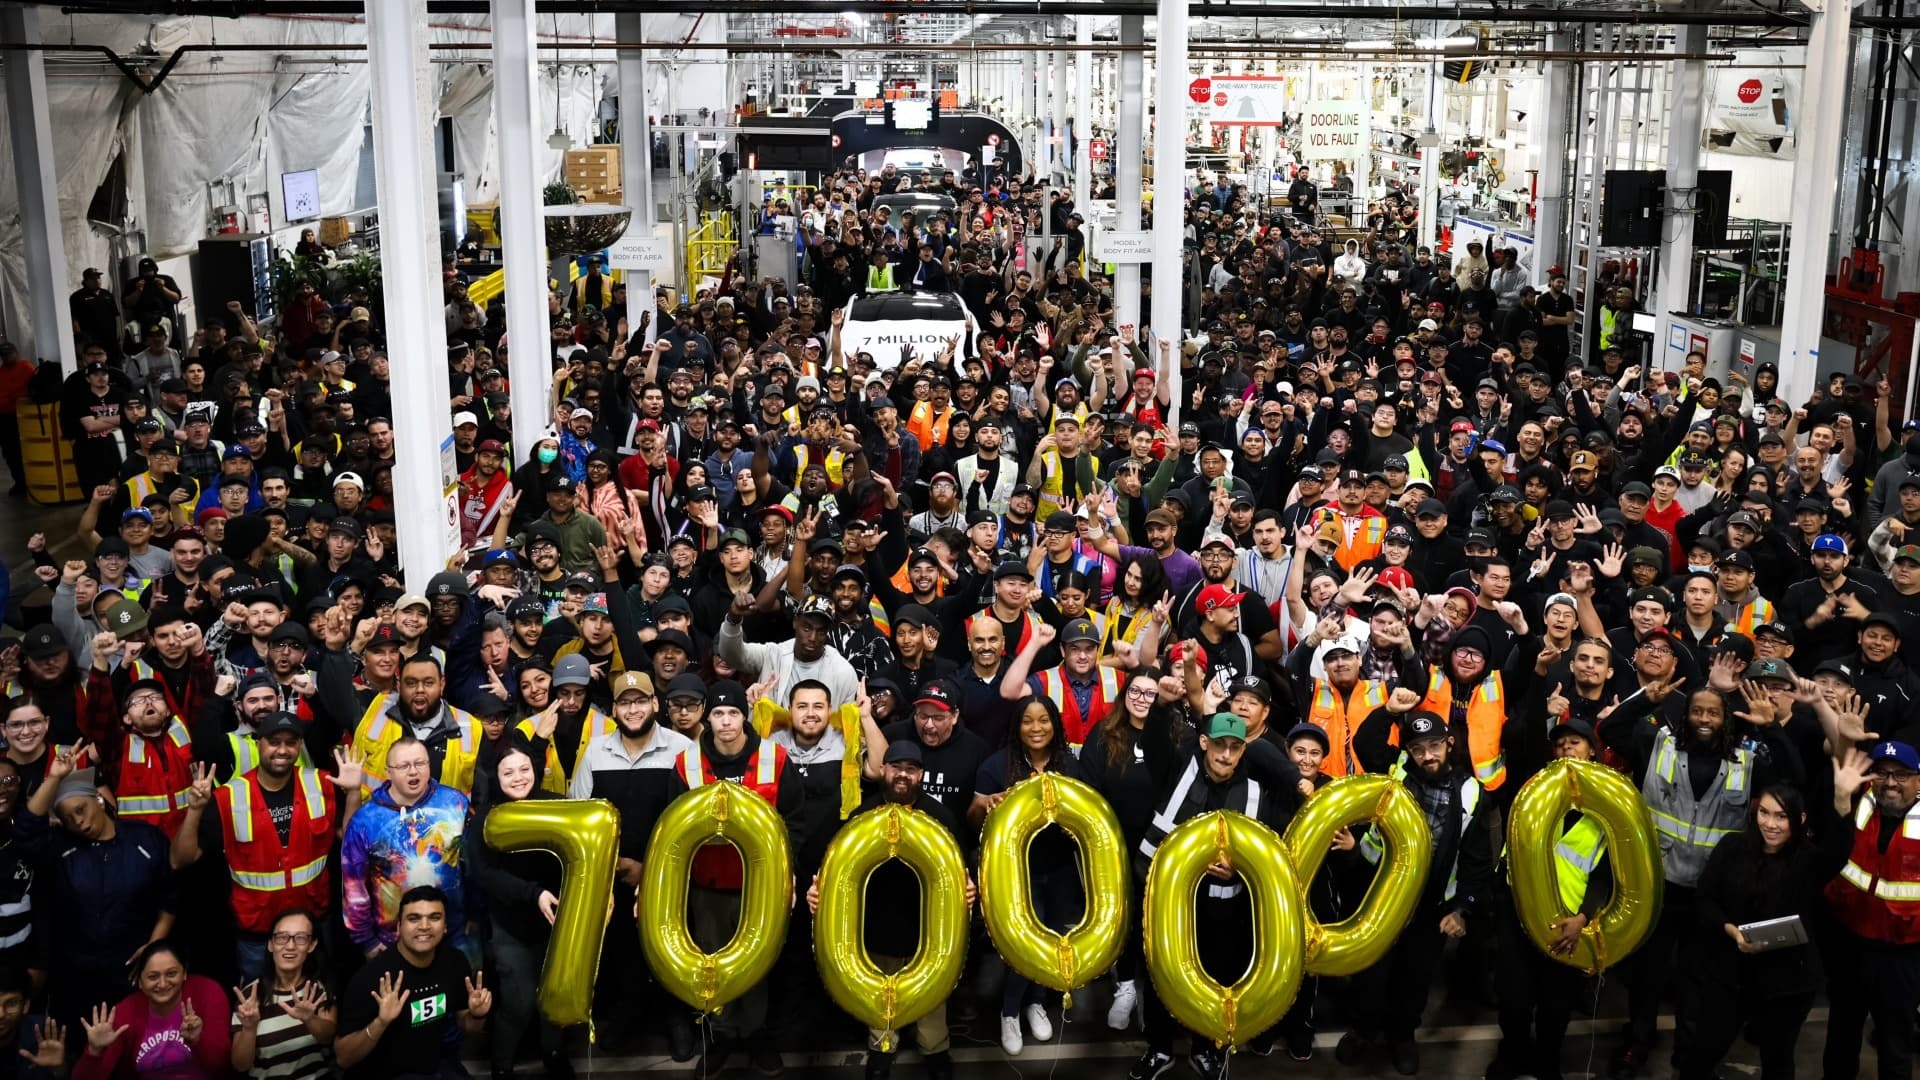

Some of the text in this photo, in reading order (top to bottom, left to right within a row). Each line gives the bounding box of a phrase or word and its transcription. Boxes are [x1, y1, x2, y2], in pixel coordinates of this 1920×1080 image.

[1740, 87, 1761, 95] STOP
[1310, 113, 1359, 127] DOORLINE
[1310, 132, 1359, 146] VDL FAULT
[863, 335, 951, 346] 7 MILLION
[923, 784, 960, 793] UCTION
[424, 999, 434, 1018] 5
[136, 1030, 192, 1064] EROPOSTA
